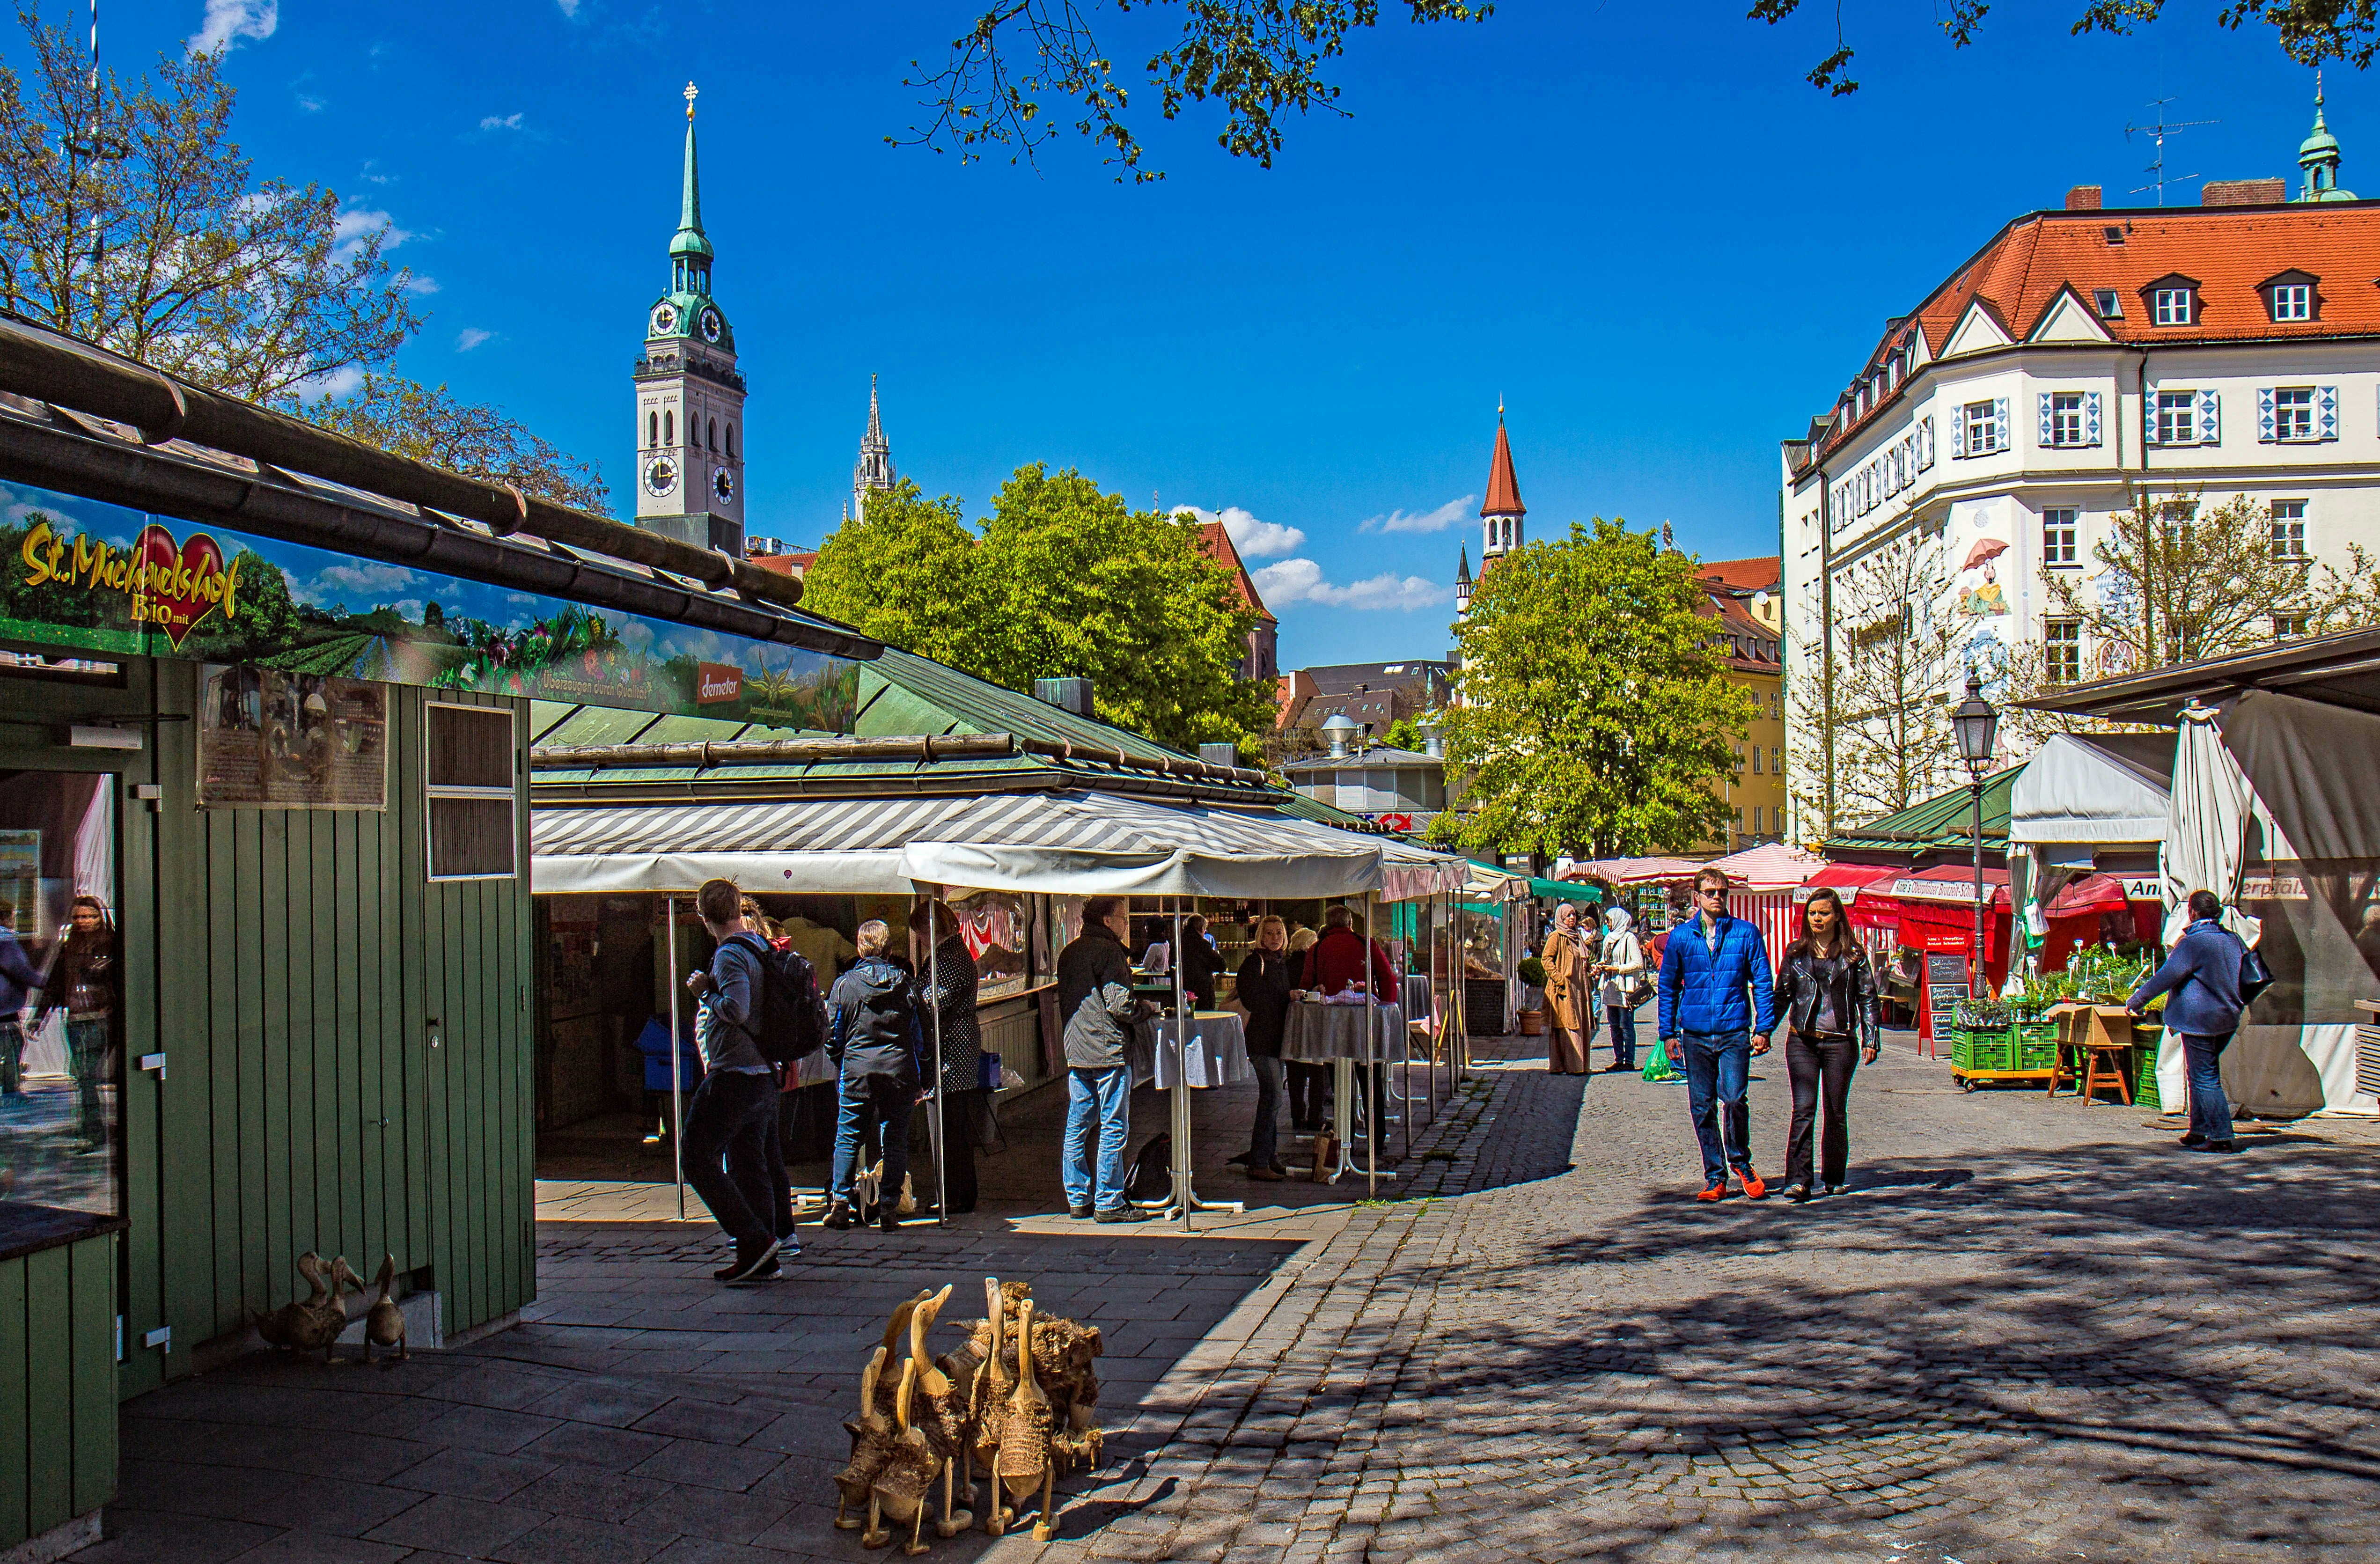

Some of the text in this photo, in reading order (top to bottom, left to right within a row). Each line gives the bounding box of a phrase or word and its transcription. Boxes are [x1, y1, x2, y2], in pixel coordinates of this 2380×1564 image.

[130, 593, 190, 625] Bio mit
[543, 669, 647, 699] Überzeugen durch Qualität
[702, 674, 738, 698] demeter
[1911, 881, 1939, 896] Oberpfälzer
